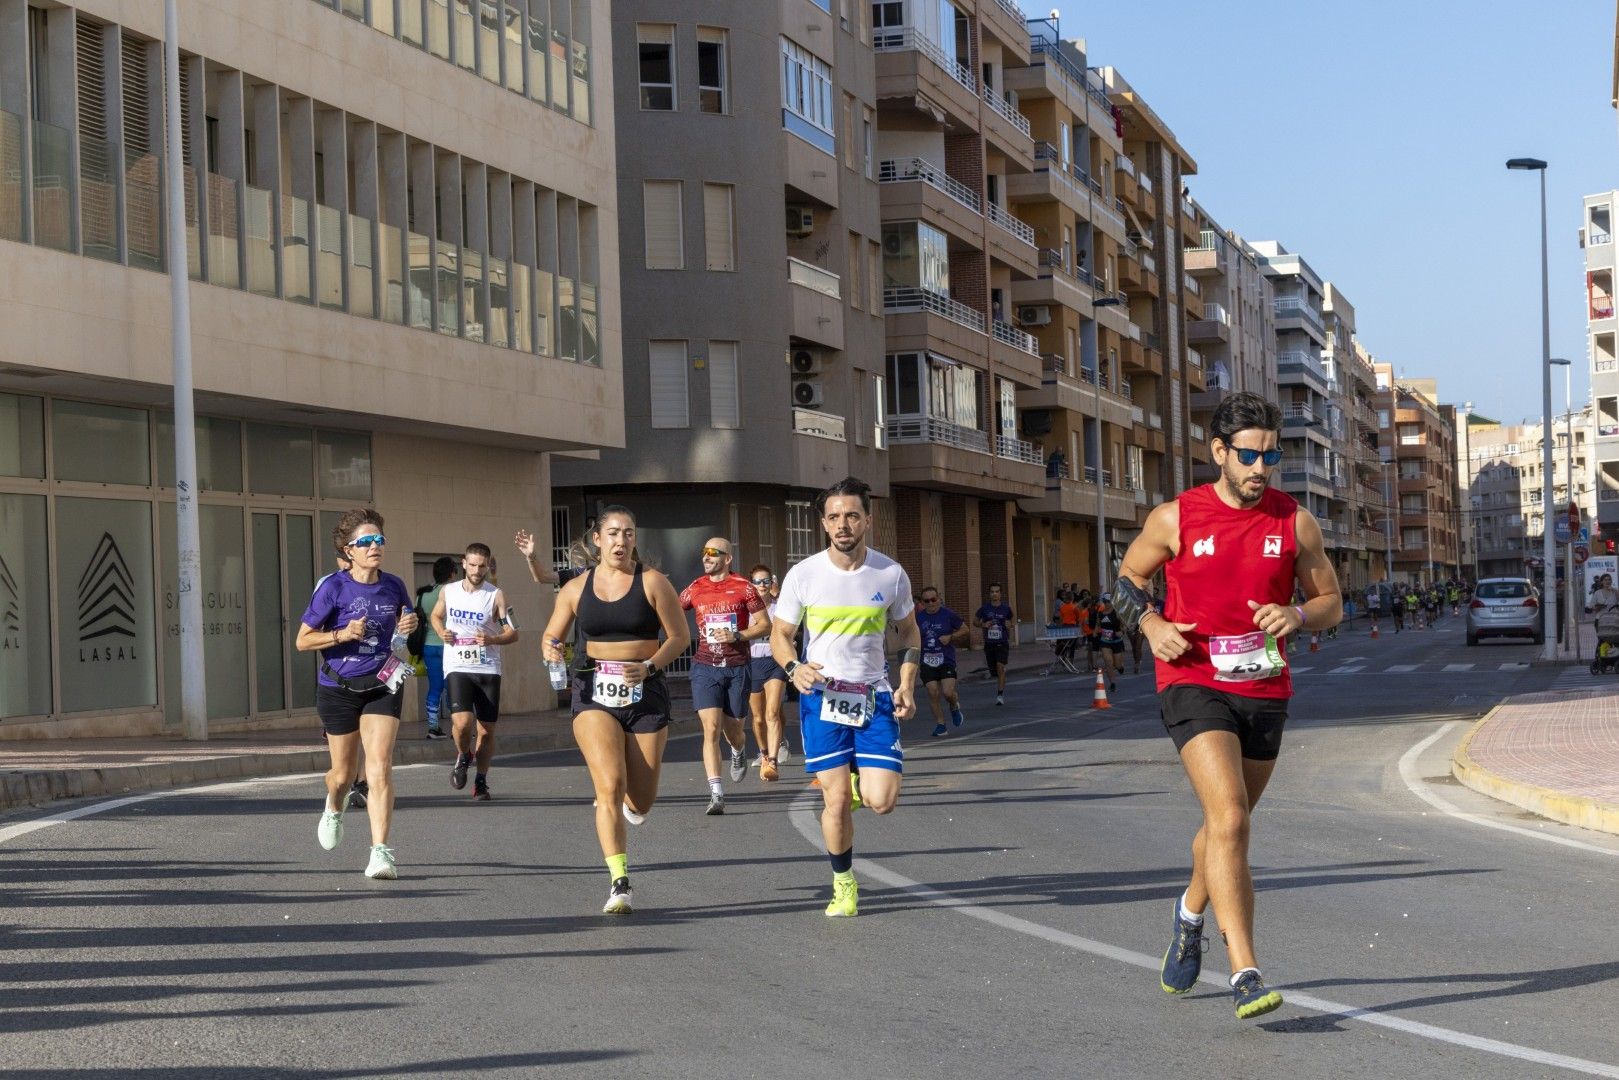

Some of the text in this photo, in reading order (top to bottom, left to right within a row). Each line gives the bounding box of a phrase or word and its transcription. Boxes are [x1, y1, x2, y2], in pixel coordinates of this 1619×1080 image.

[449, 607, 484, 621] torre
[80, 647, 137, 662] LASAL
[458, 649, 478, 660] 181
[596, 682, 630, 698] 198
[827, 699, 863, 717] 184
